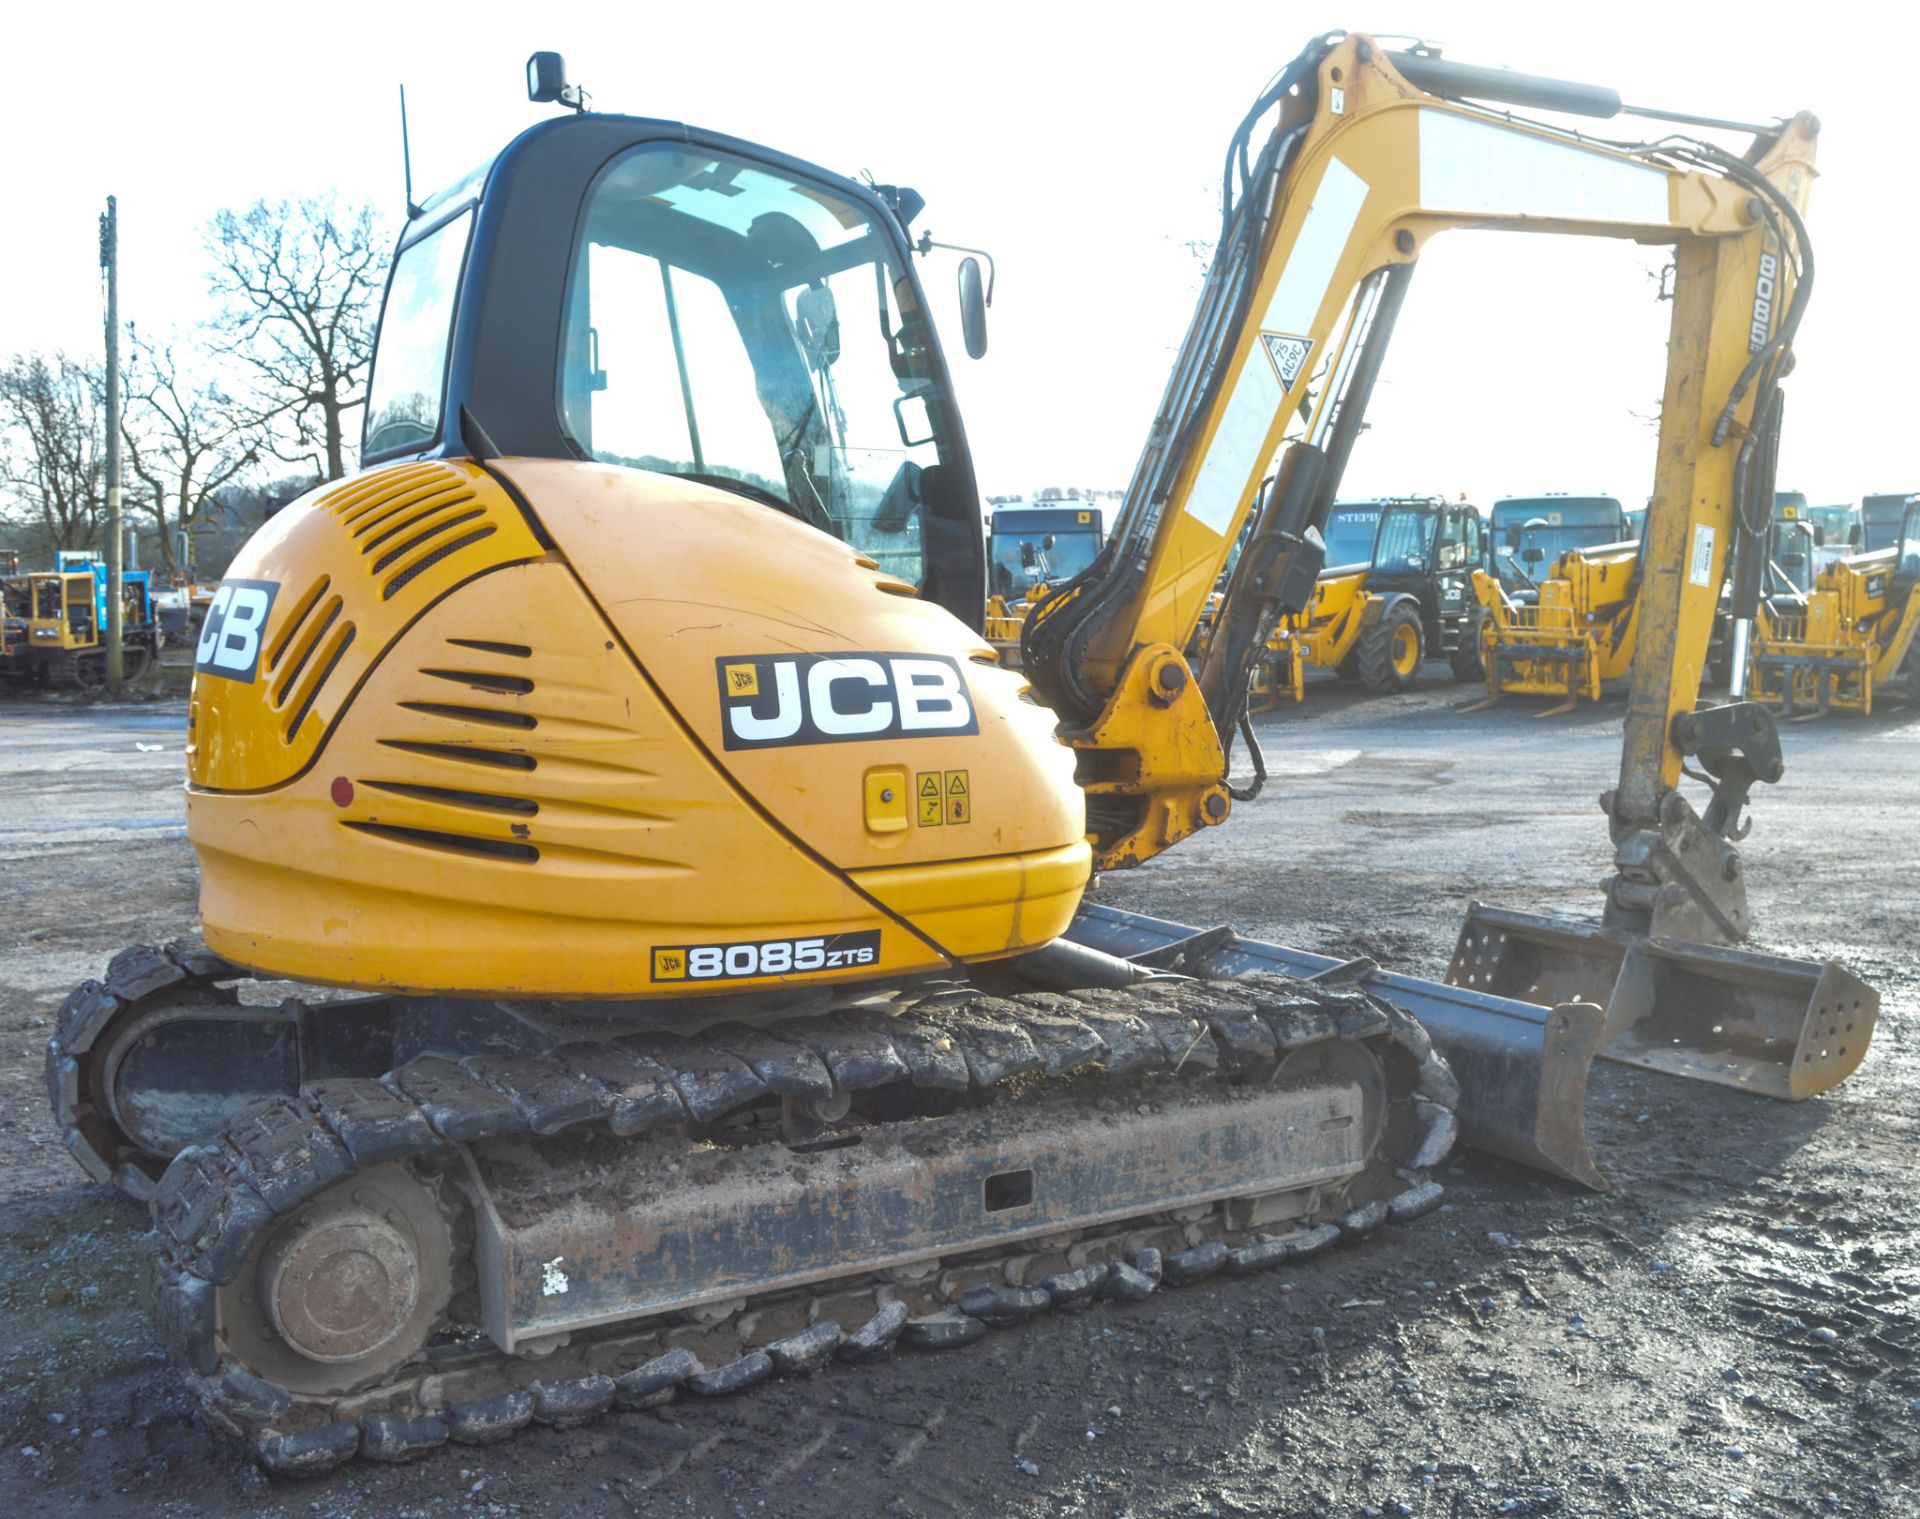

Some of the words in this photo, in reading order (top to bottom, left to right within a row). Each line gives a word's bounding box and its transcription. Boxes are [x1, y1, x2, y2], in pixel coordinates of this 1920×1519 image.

[1750, 253, 1777, 346] 8085
[1275, 341, 1289, 360] 75
[1445, 589, 1461, 600] JCB
[195, 586, 269, 671] CB
[734, 671, 753, 688] JCB
[730, 658, 971, 741] JCB
[663, 957, 680, 971] JCB
[689, 939, 825, 978] 8085
